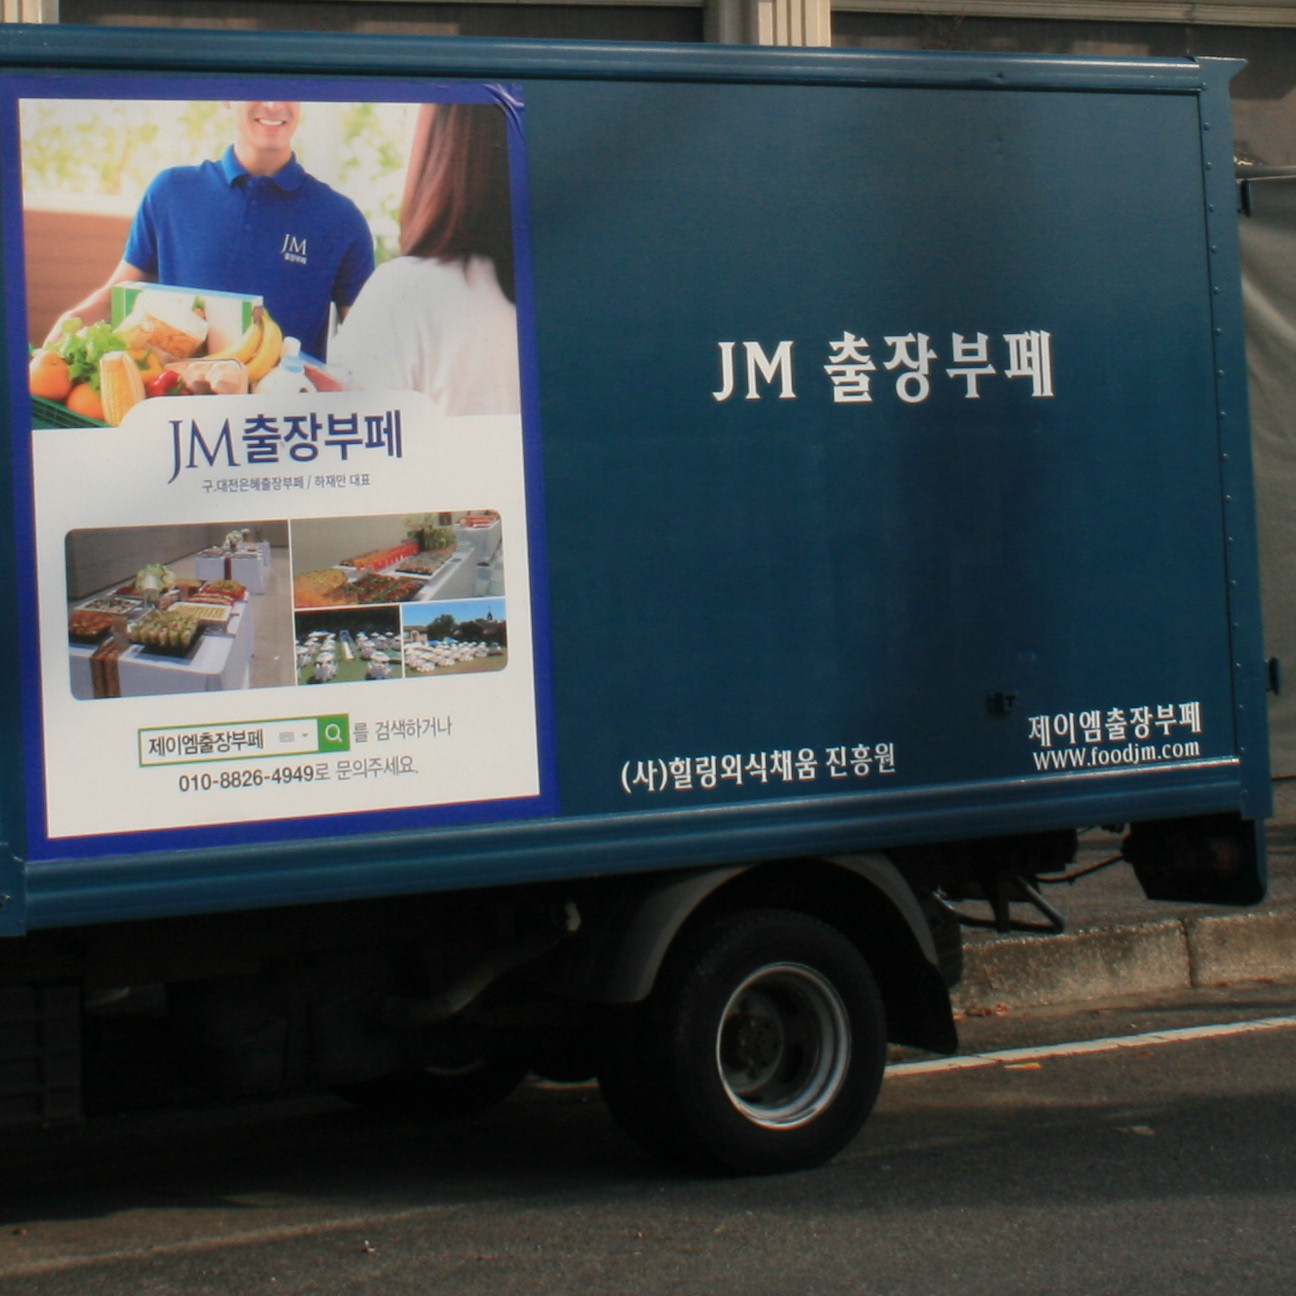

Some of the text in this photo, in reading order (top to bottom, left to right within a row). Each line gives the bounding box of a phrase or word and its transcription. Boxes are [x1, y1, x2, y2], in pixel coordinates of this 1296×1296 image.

[280, 233, 307, 255] JM
[712, 330, 1054, 403] JM 출장부페
[349, 473, 371, 487] 대표
[149, 716, 453, 757] 제이엠출장부페 를 검색하거나
[1028, 701, 1202, 747] 제이엠출장부페
[178, 755, 419, 792] 010-8826-4949로 문의주세요.
[621, 742, 896, 794] (사)힐링외식채움 진흥원
